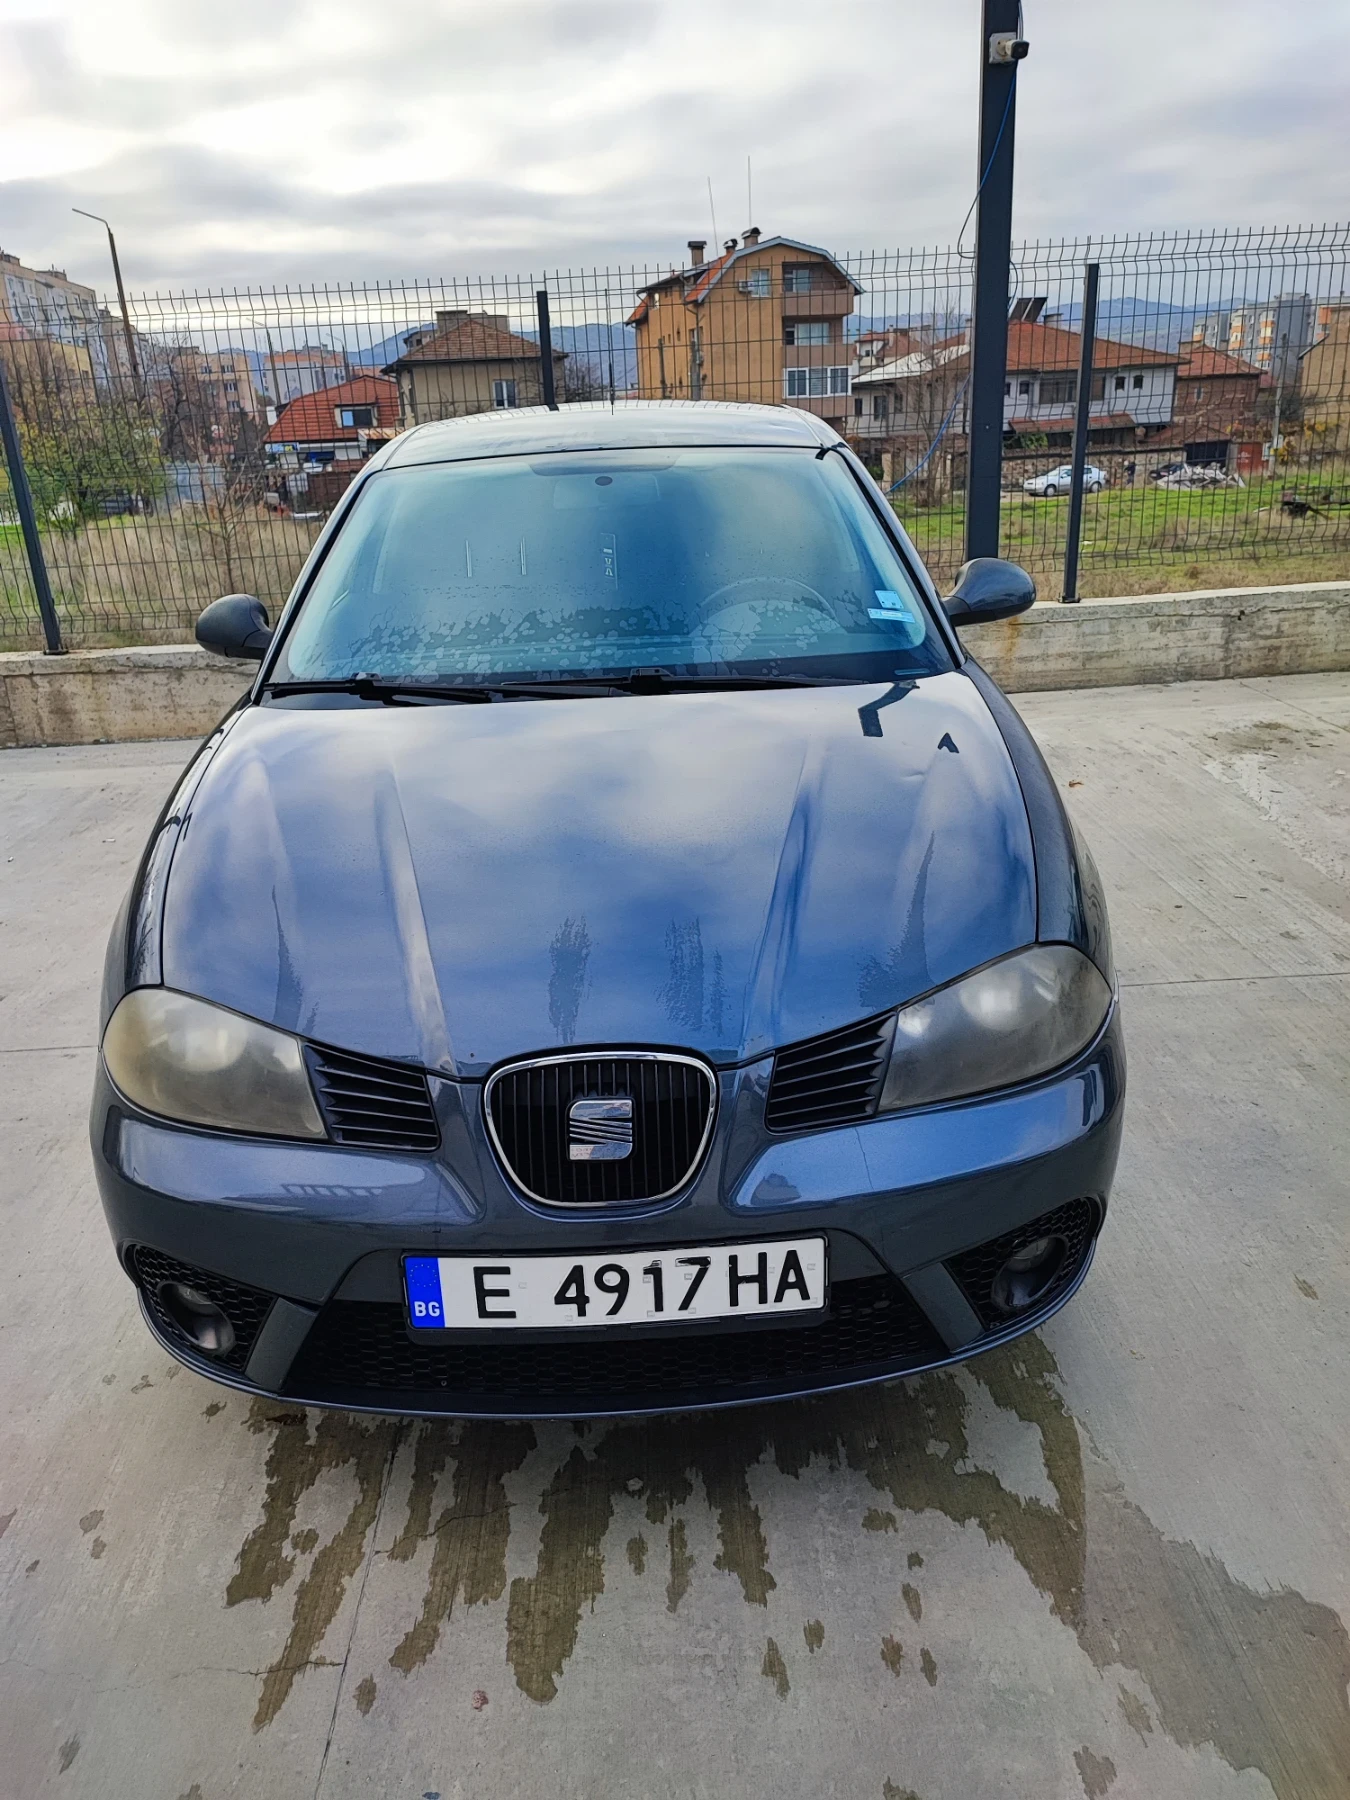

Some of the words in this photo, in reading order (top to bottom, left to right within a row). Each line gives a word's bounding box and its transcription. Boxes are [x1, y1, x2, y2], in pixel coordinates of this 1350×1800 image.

[473, 1266, 517, 1319] E
[554, 1256, 711, 1317] 4917
[728, 1249, 811, 1308] HA
[414, 1301, 440, 1317] BG
